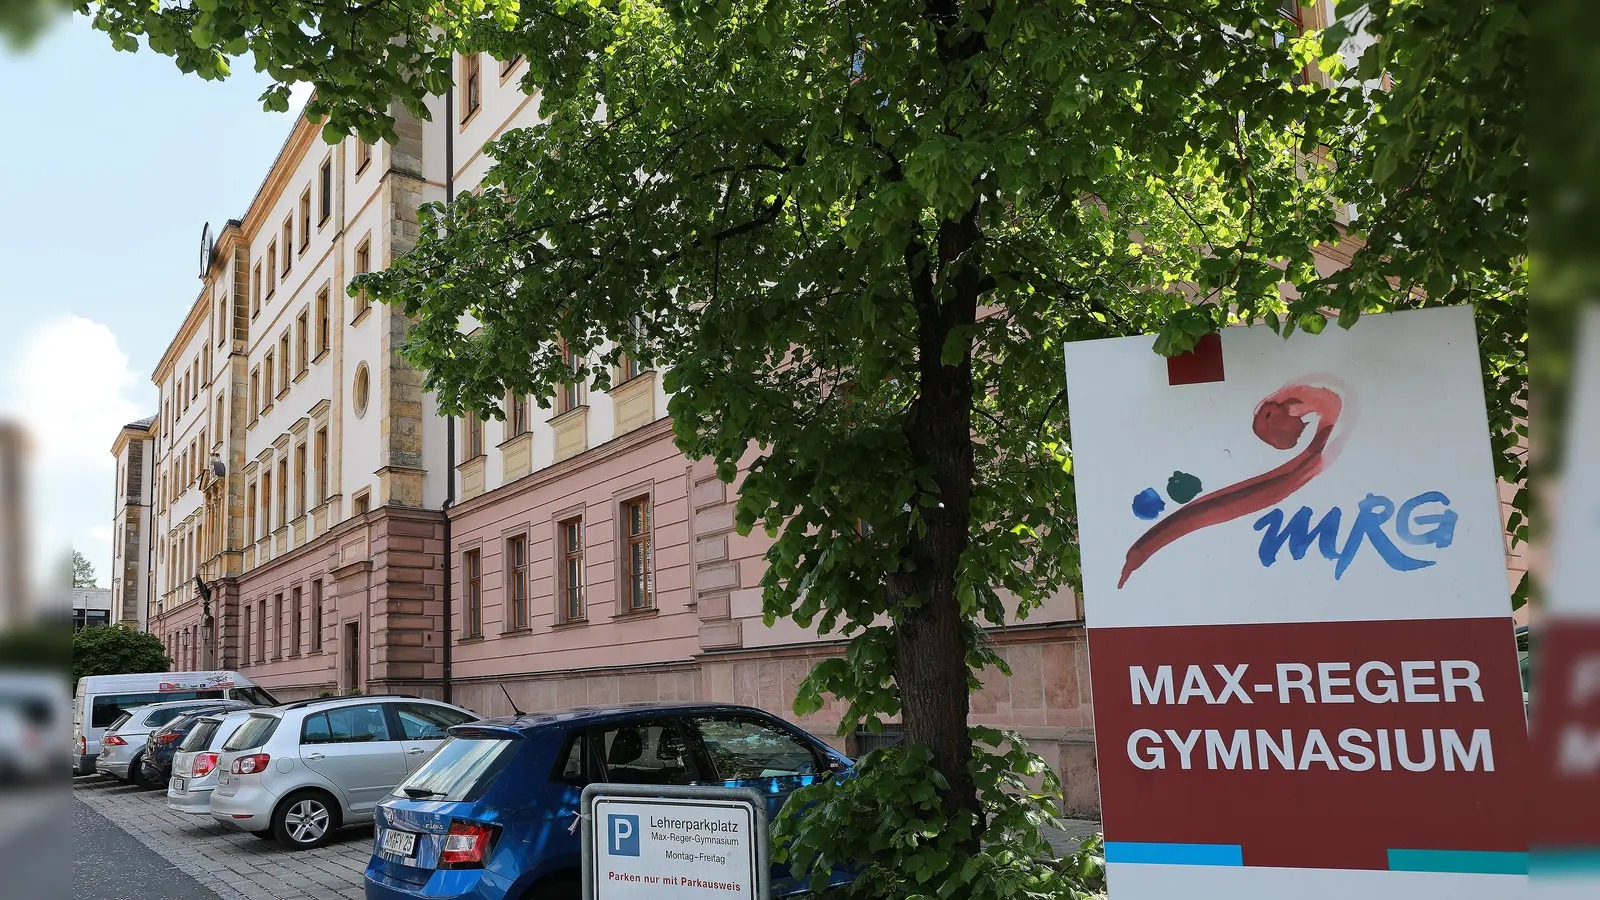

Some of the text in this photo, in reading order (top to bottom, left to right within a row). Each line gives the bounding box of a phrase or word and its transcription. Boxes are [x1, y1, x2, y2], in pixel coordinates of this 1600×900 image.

[1253, 491, 1458, 580] MRG
[1129, 659, 1485, 705] MAX-REGER
[1126, 728, 1495, 772] GYMNASIUM
[650, 816, 738, 833] Lehrerparkplatz
[651, 832, 739, 845] Max-Reger-Gymnasium
[608, 871, 741, 891] Parken nur mit Parkausweis
